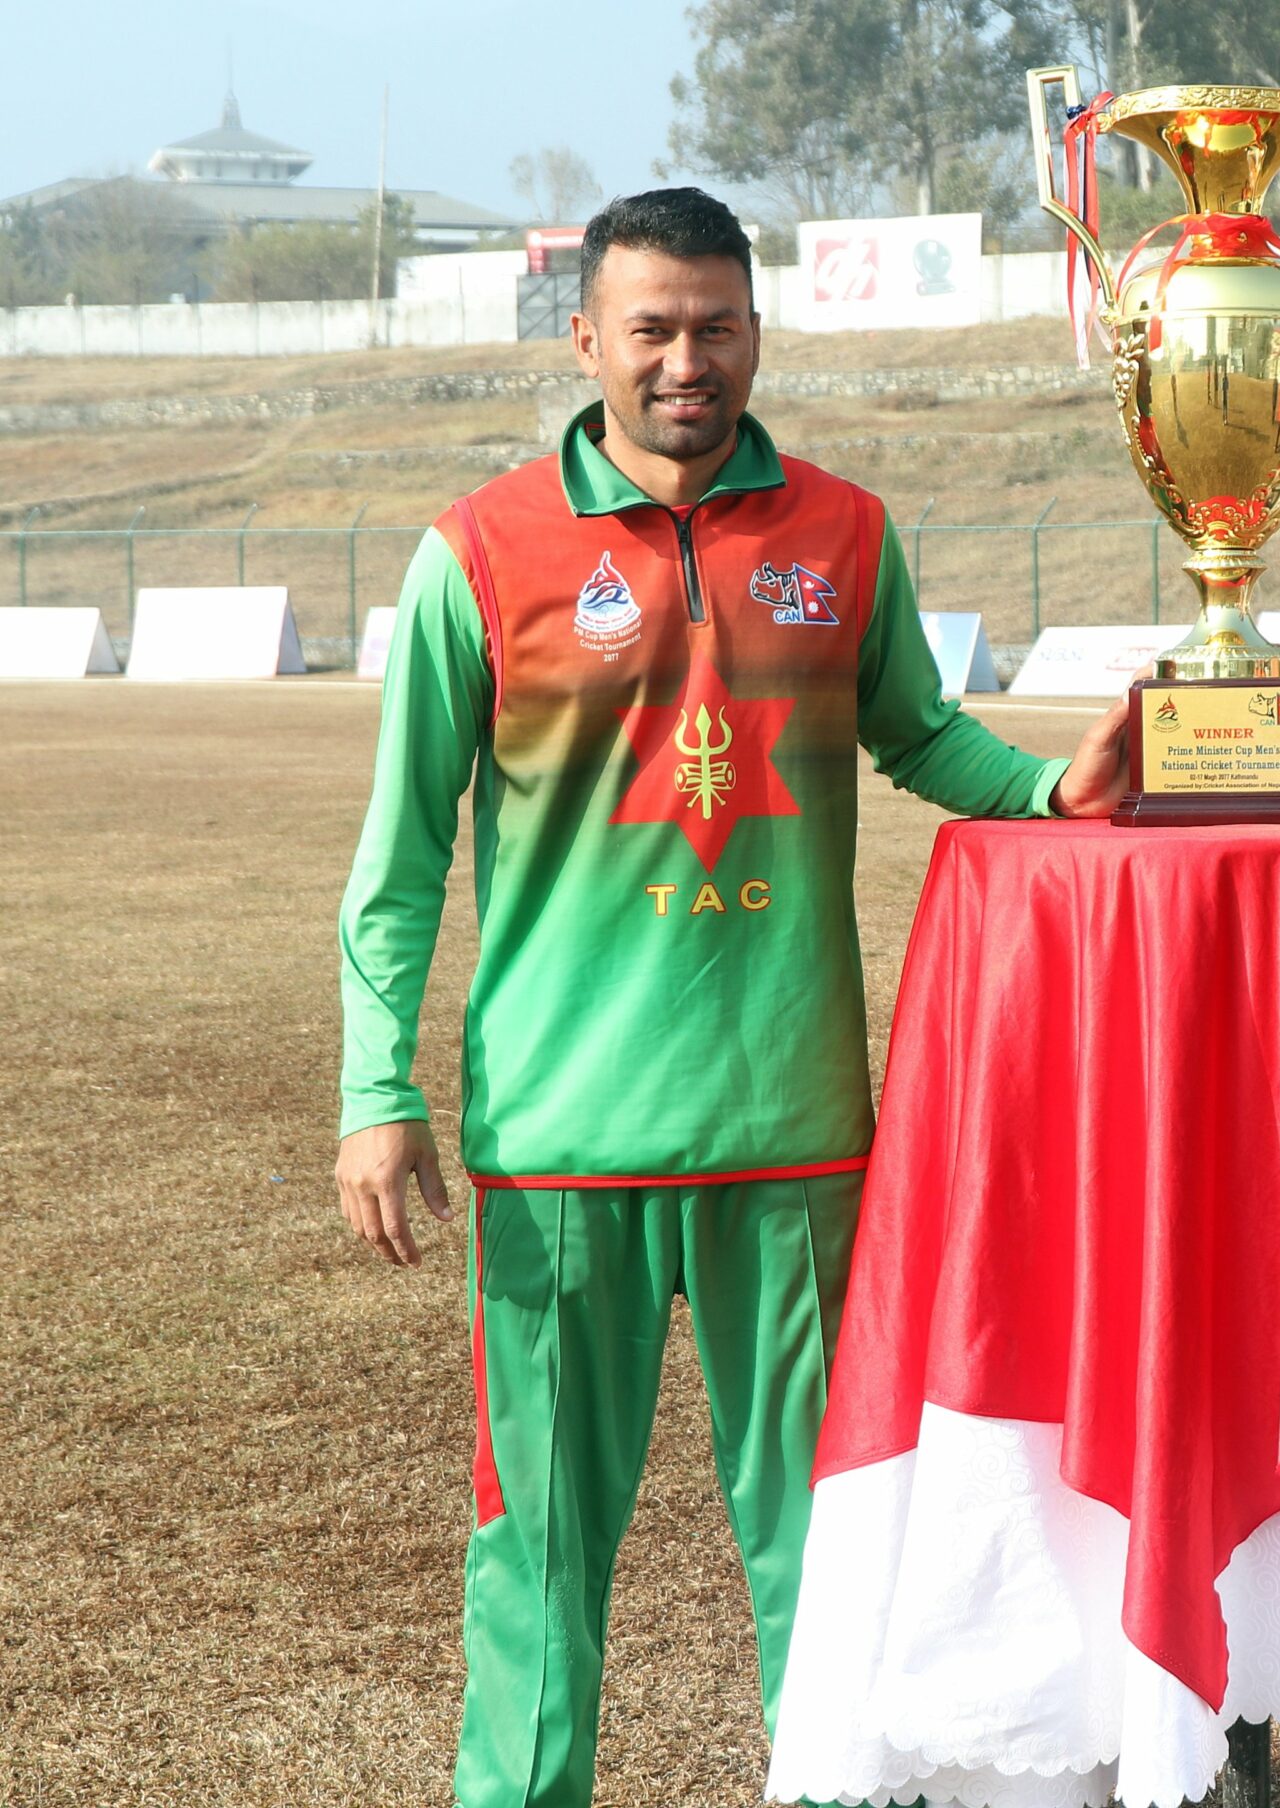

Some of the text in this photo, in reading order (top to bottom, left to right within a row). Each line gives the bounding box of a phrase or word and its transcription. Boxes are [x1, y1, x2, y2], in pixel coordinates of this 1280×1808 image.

[775, 610, 801, 622] CAN
[585, 631, 598, 641] Cup
[599, 633, 617, 641] Men's
[618, 619, 643, 638] National
[580, 633, 642, 651] Cricket Tournament
[603, 653, 619, 662] 2077
[1193, 728, 1254, 740] WINNER
[1167, 745, 1280, 757] Prime Minister Cup Men's
[1161, 760, 1198, 770] National
[1201, 760, 1232, 770] Cricket
[646, 879, 771, 916] TAC
